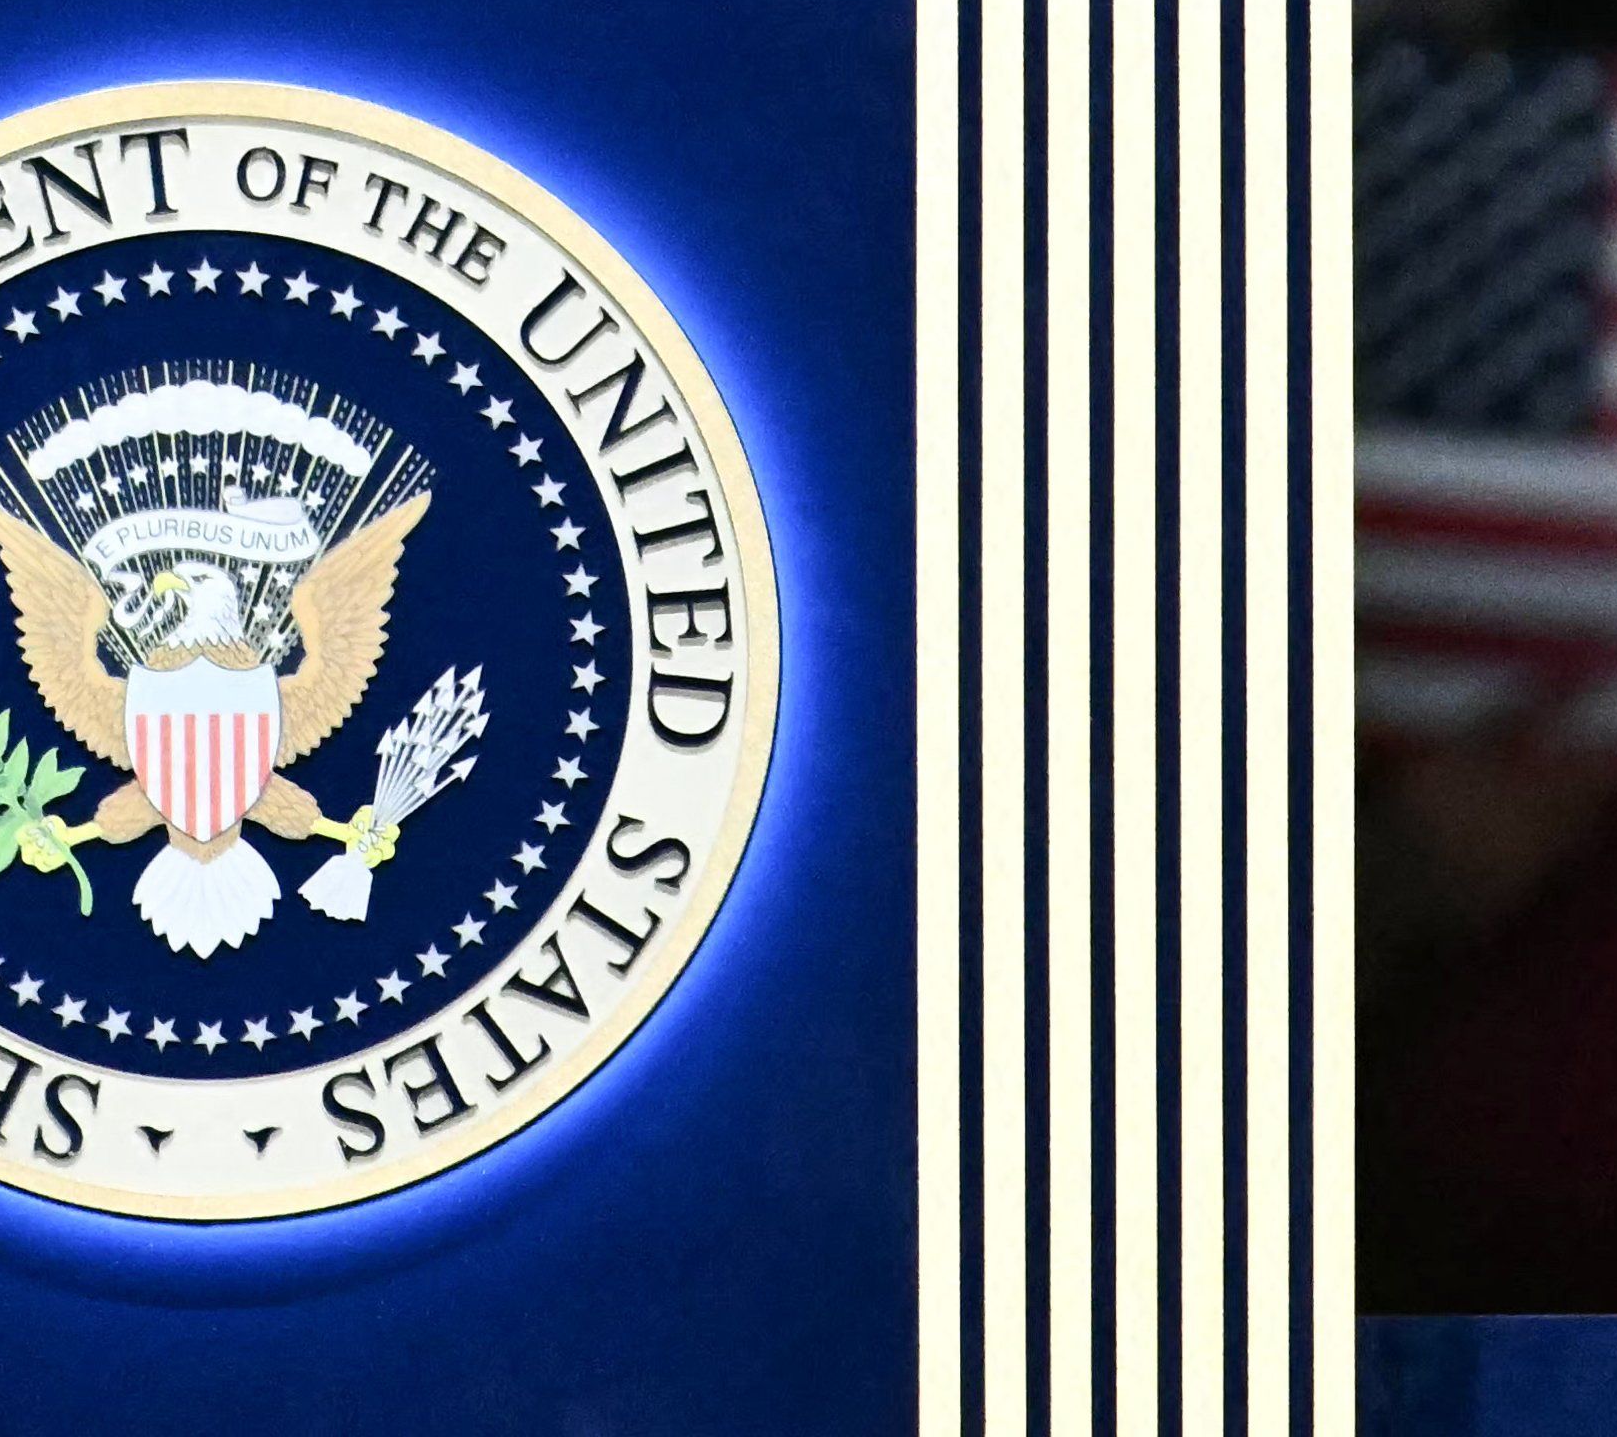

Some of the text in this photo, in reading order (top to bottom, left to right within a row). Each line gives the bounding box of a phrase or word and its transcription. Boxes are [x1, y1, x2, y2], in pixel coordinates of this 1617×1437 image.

[236, 145, 339, 210] OF
[365, 172, 507, 286] THE
[95, 518, 309, 559] E PLURIBUS UNUM
[519, 268, 735, 748] UNITED
[321, 814, 691, 1162] STATES
